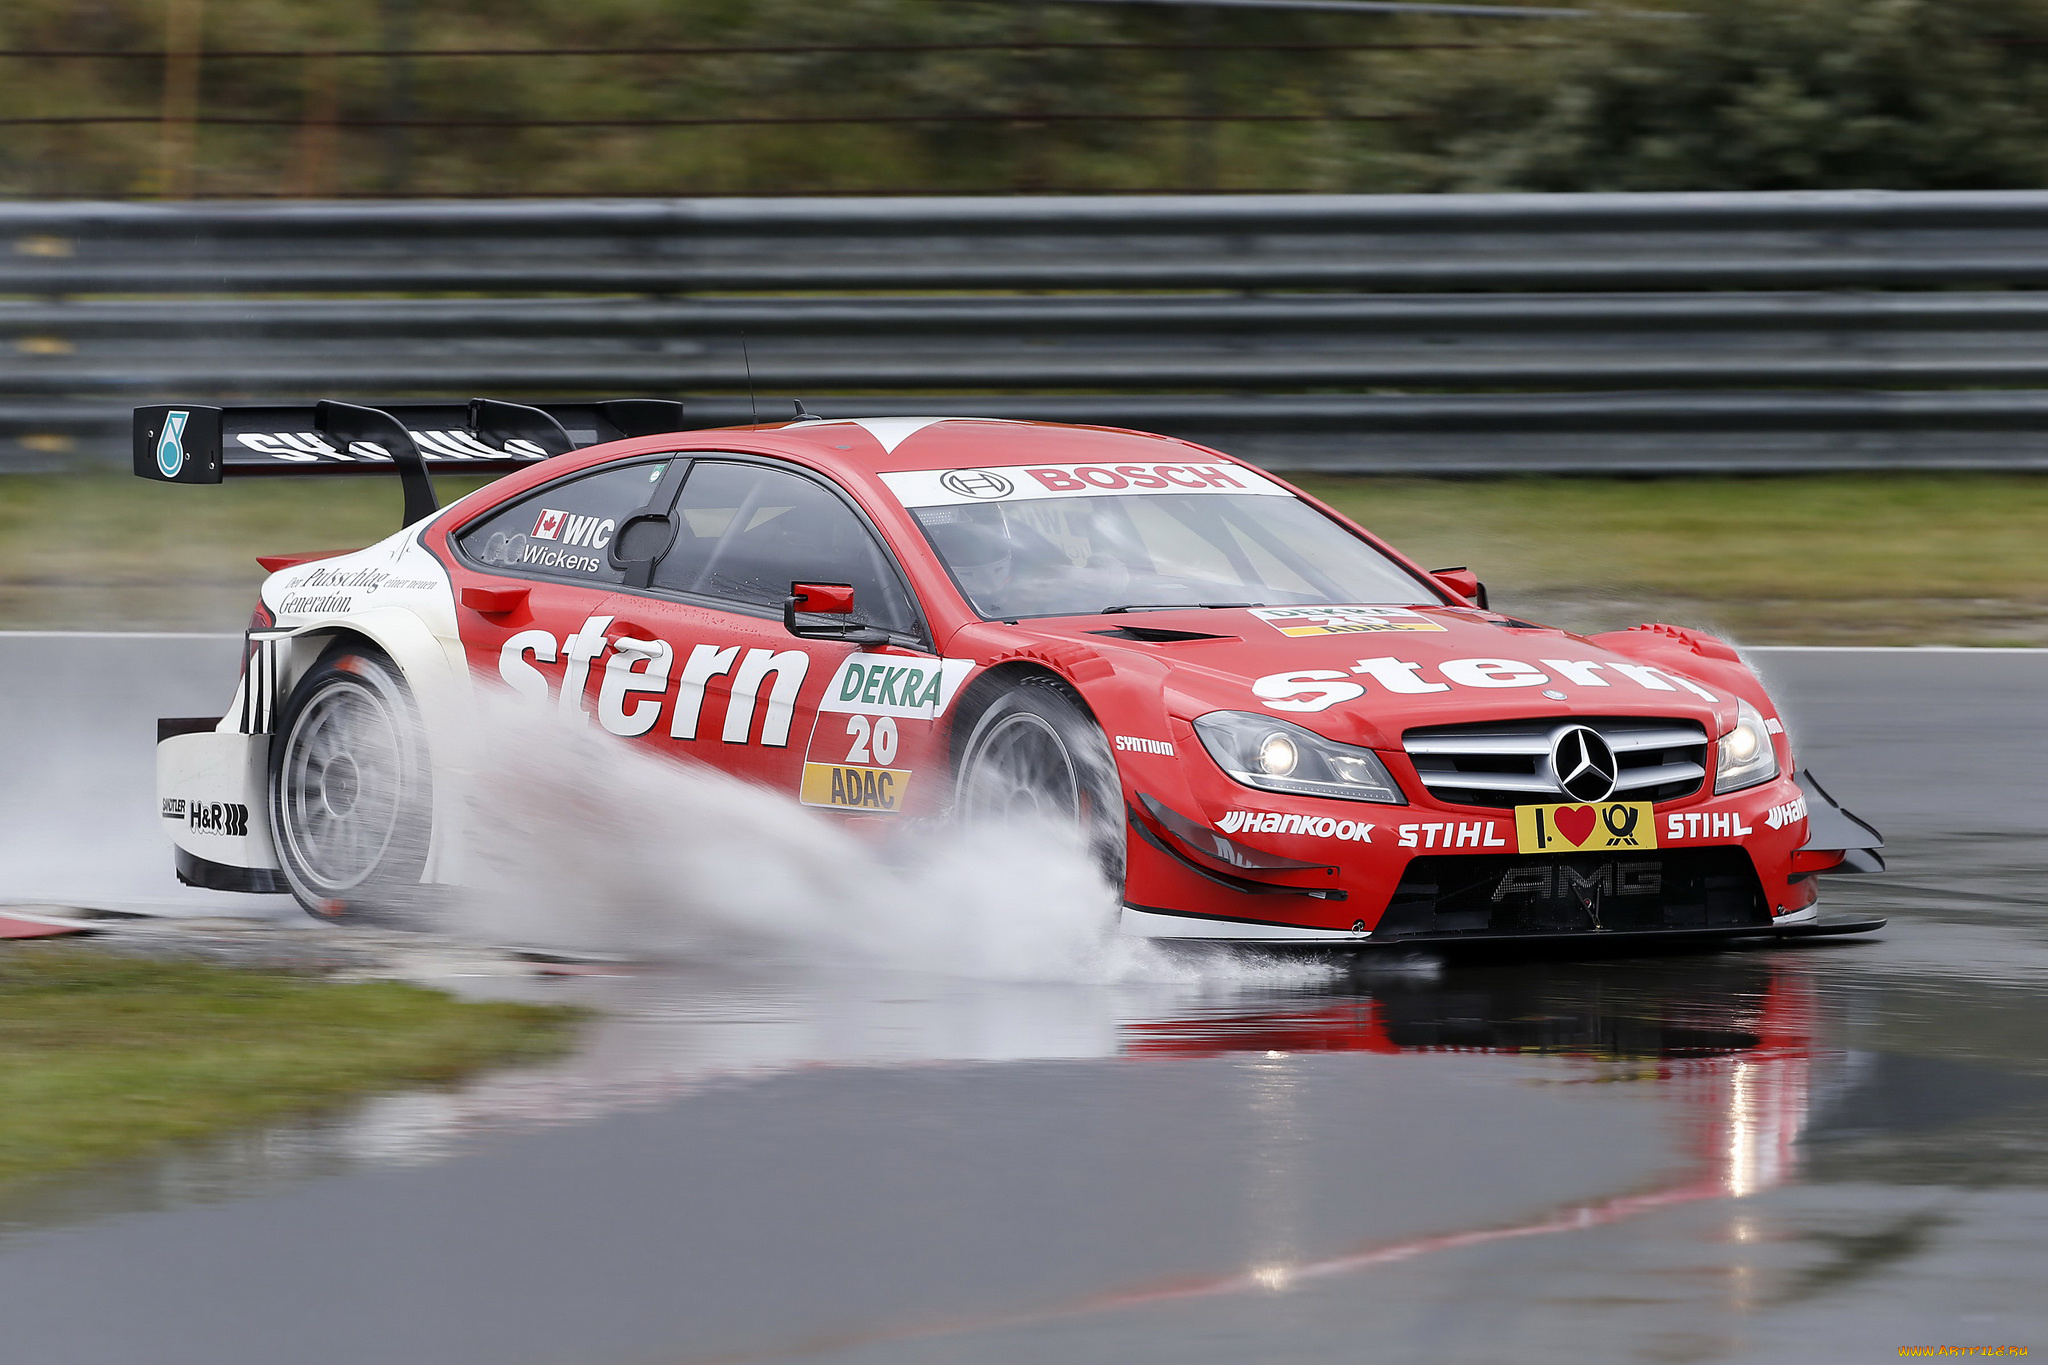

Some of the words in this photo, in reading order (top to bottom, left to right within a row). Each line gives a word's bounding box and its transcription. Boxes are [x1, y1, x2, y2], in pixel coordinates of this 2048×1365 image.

[1024, 465, 1248, 492] BOSCH
[563, 514, 615, 549] WIC
[523, 544, 600, 572] Wickens
[285, 576, 304, 589] Der
[302, 567, 391, 594] Pulsschlag
[383, 576, 409, 590] einer
[406, 580, 438, 590] neuen
[279, 590, 352, 614] Generation.
[1262, 607, 1400, 617] DEKRA
[1320, 623, 1416, 633] ADAC
[499, 616, 810, 748] stern
[840, 662, 941, 709] DEKRA
[1251, 655, 1720, 713] stern
[844, 715, 898, 766] 20
[1115, 735, 1175, 757] SYNTIUM
[831, 767, 894, 808] ADAC
[190, 801, 225, 834] H&R
[1667, 813, 1753, 839] STIHL
[1397, 821, 1506, 848] STIHL
[1491, 861, 1662, 902] AMG
